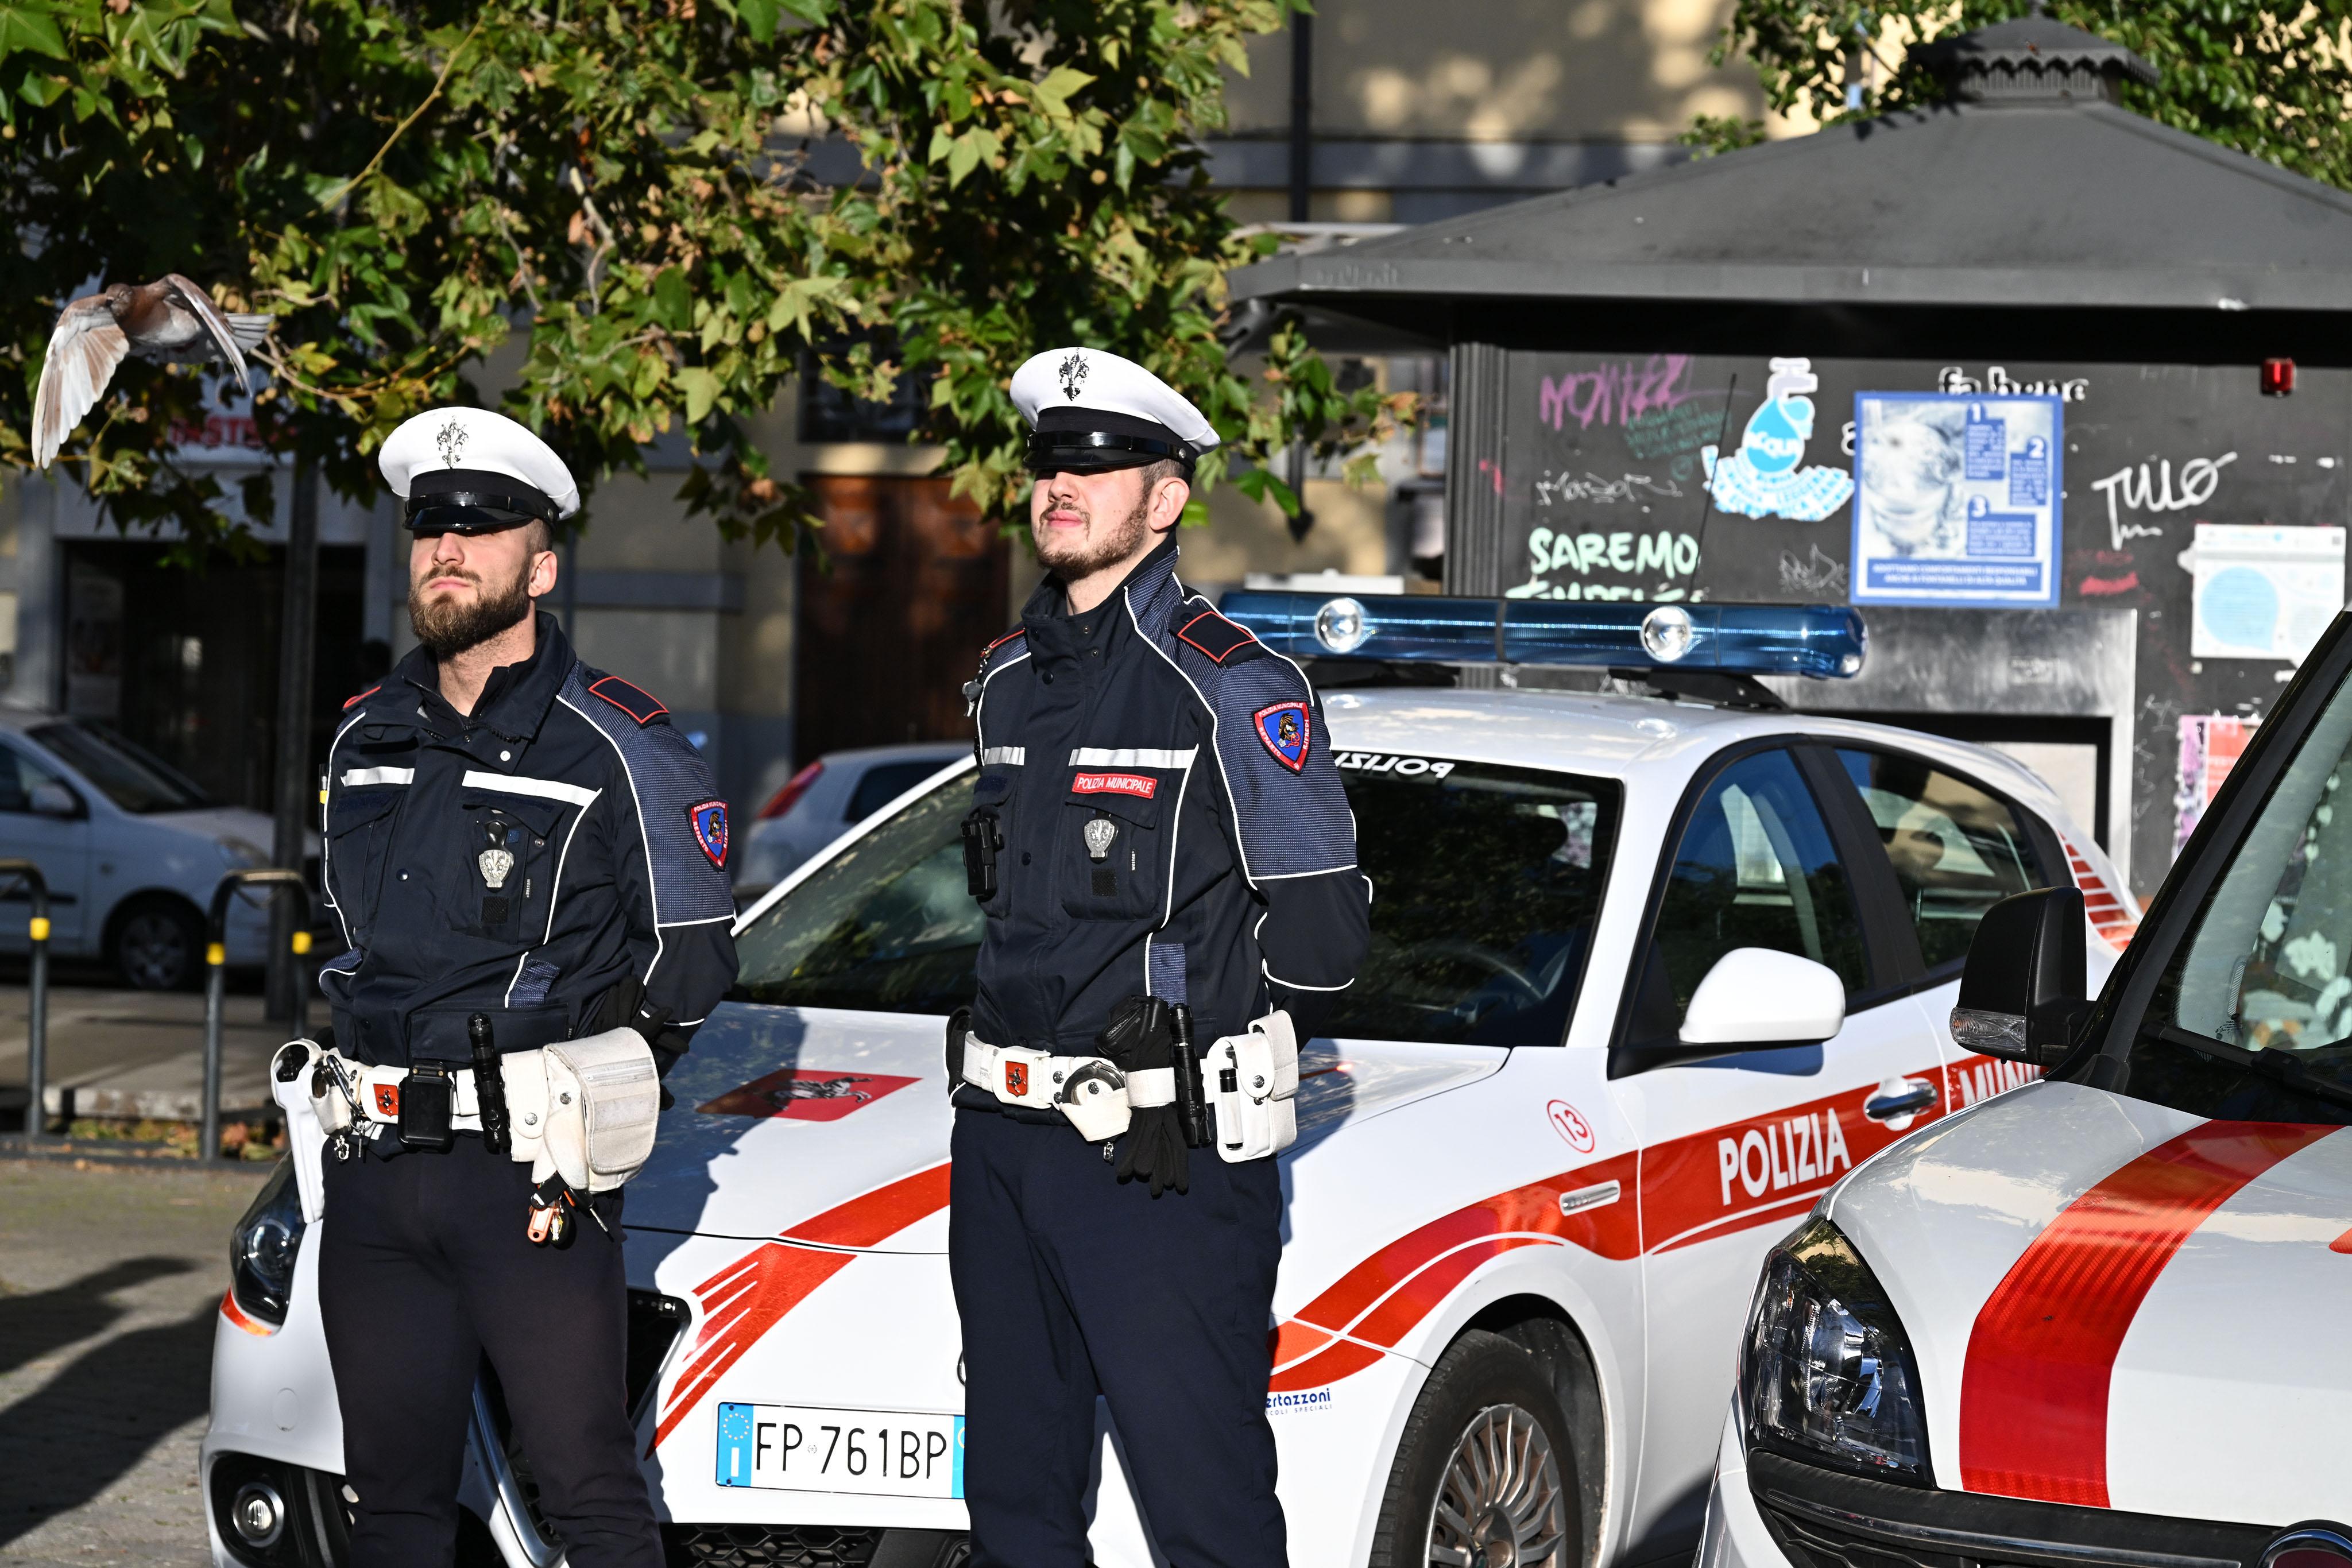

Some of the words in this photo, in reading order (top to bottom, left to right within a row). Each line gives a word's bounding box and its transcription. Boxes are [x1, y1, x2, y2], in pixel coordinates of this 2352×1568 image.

[1971, 404, 1981, 422] 1
[2029, 440, 2045, 458] 2
[1971, 498, 1986, 517] 3
[1529, 527, 1699, 579] SAREMO
[1258, 706, 1277, 717] POLIZIA
[1277, 702, 1303, 711] MUNICIPALE
[1258, 727, 1282, 757] REPARTO
[1077, 777, 1104, 789] POLIZIA
[1105, 777, 1152, 793] MUNICIPALE
[693, 822, 709, 852] REPARTO
[1554, 1109, 1588, 1141] 13
[1719, 1108, 1851, 1205] POLIZIA
[1294, 1403, 1333, 1414] SPECIALI
[756, 1422, 803, 1472] FP
[821, 1426, 947, 1480] 761BP
